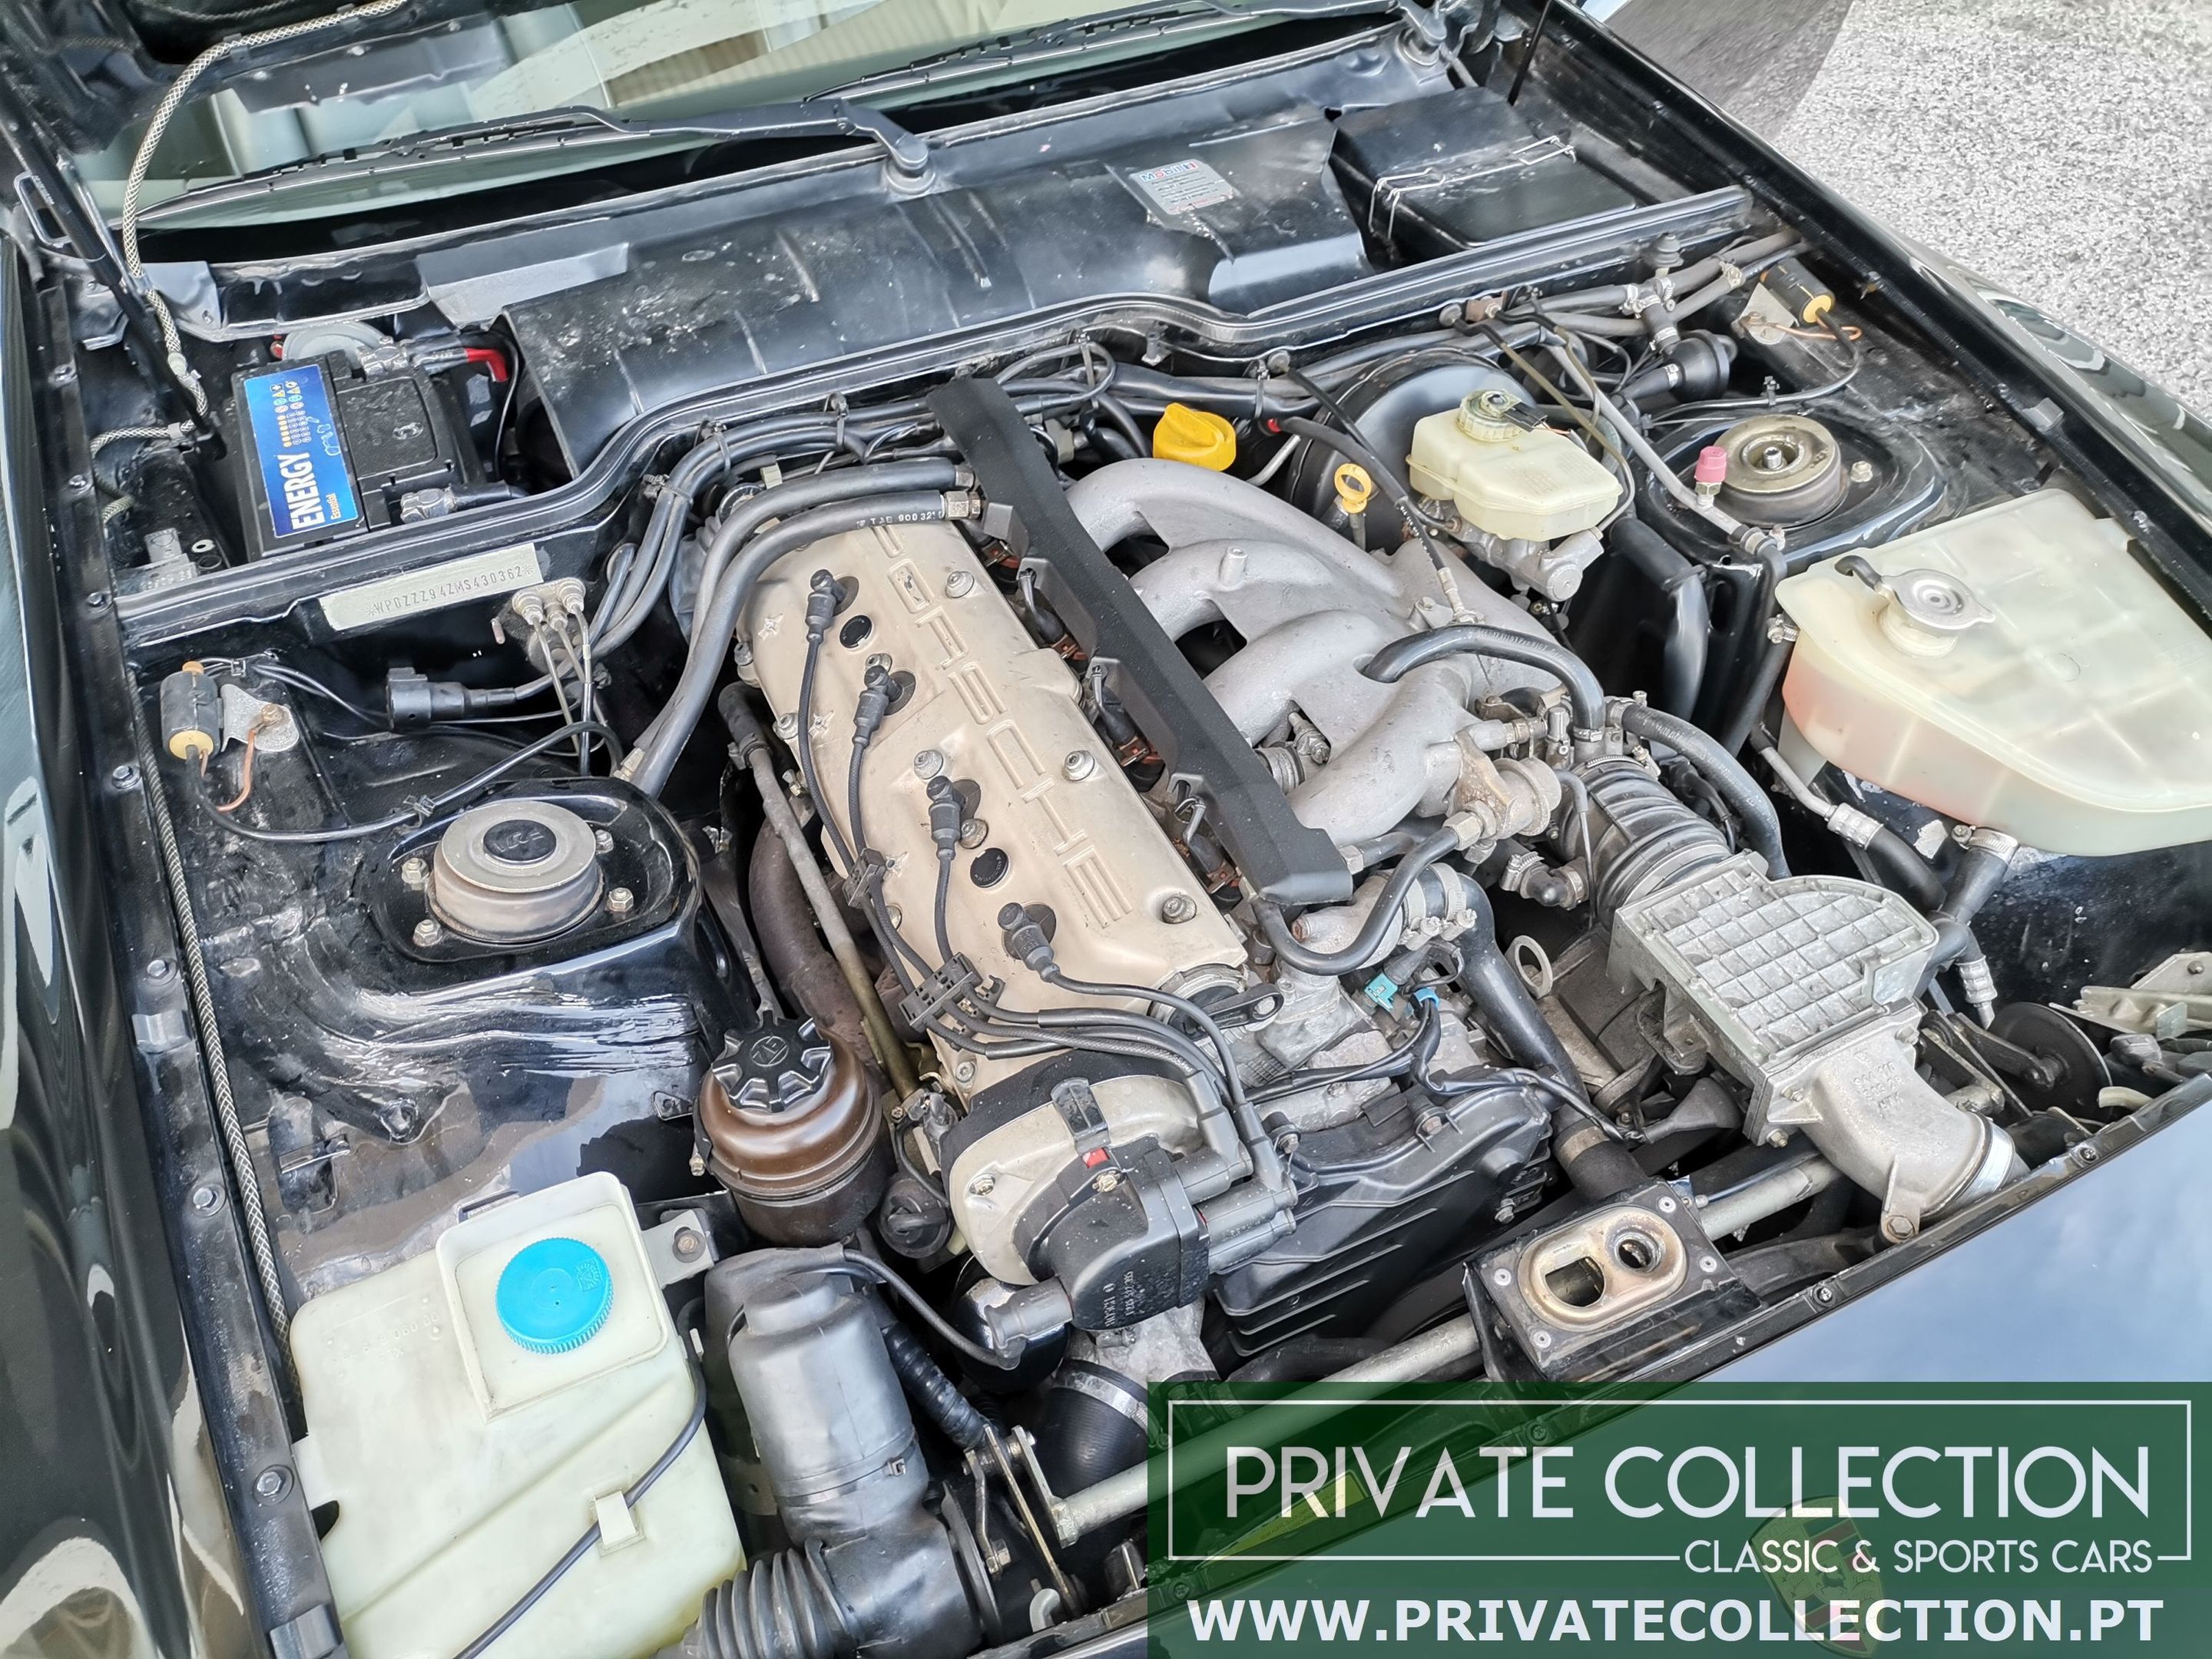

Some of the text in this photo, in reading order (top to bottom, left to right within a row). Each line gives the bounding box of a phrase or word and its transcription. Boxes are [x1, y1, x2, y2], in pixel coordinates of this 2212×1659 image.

[1141, 164, 1182, 181] Mobil
[276, 452, 326, 530] ENERGY
[326, 492, 342, 520] Essential
